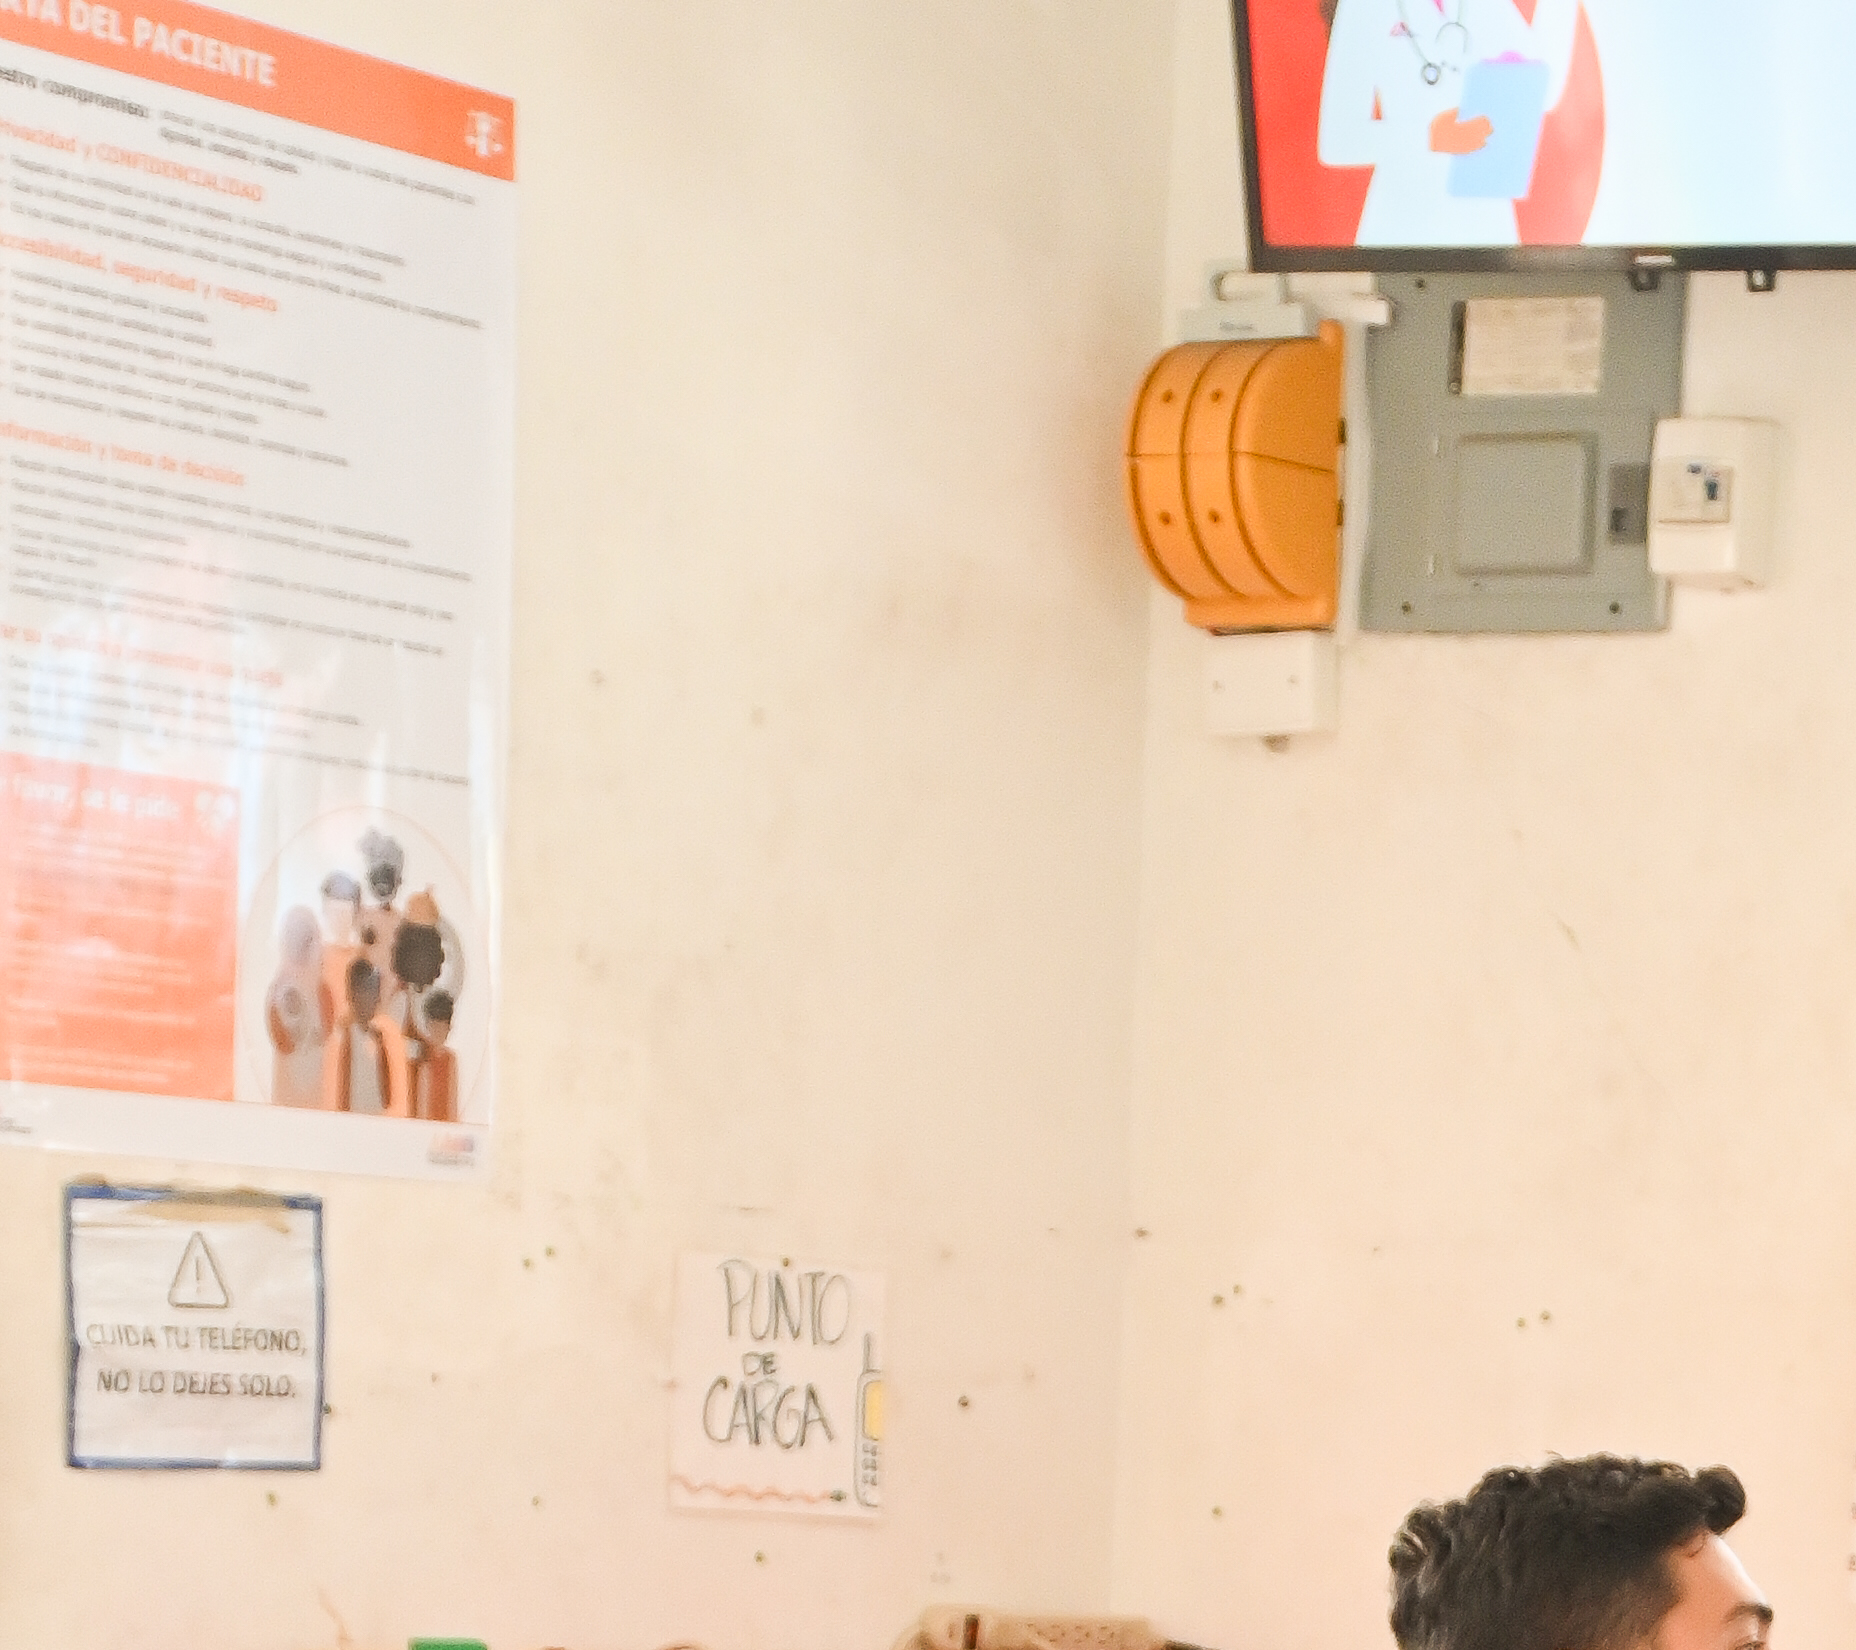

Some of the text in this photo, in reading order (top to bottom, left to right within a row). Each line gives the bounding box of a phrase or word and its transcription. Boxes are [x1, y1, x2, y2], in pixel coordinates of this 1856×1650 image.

[69, 0, 126, 45] DEL
[133, 16, 277, 88] PACIENTE
[717, 1258, 851, 1346] PUNTO
[86, 1323, 156, 1349] CUIDA
[160, 1325, 190, 1350] TU
[97, 1369, 130, 1393] NO
[138, 1370, 165, 1394] LO
[173, 1371, 232, 1396] DEJES
[742, 1351, 778, 1376] DE
[702, 1374, 835, 1450] CARGA
